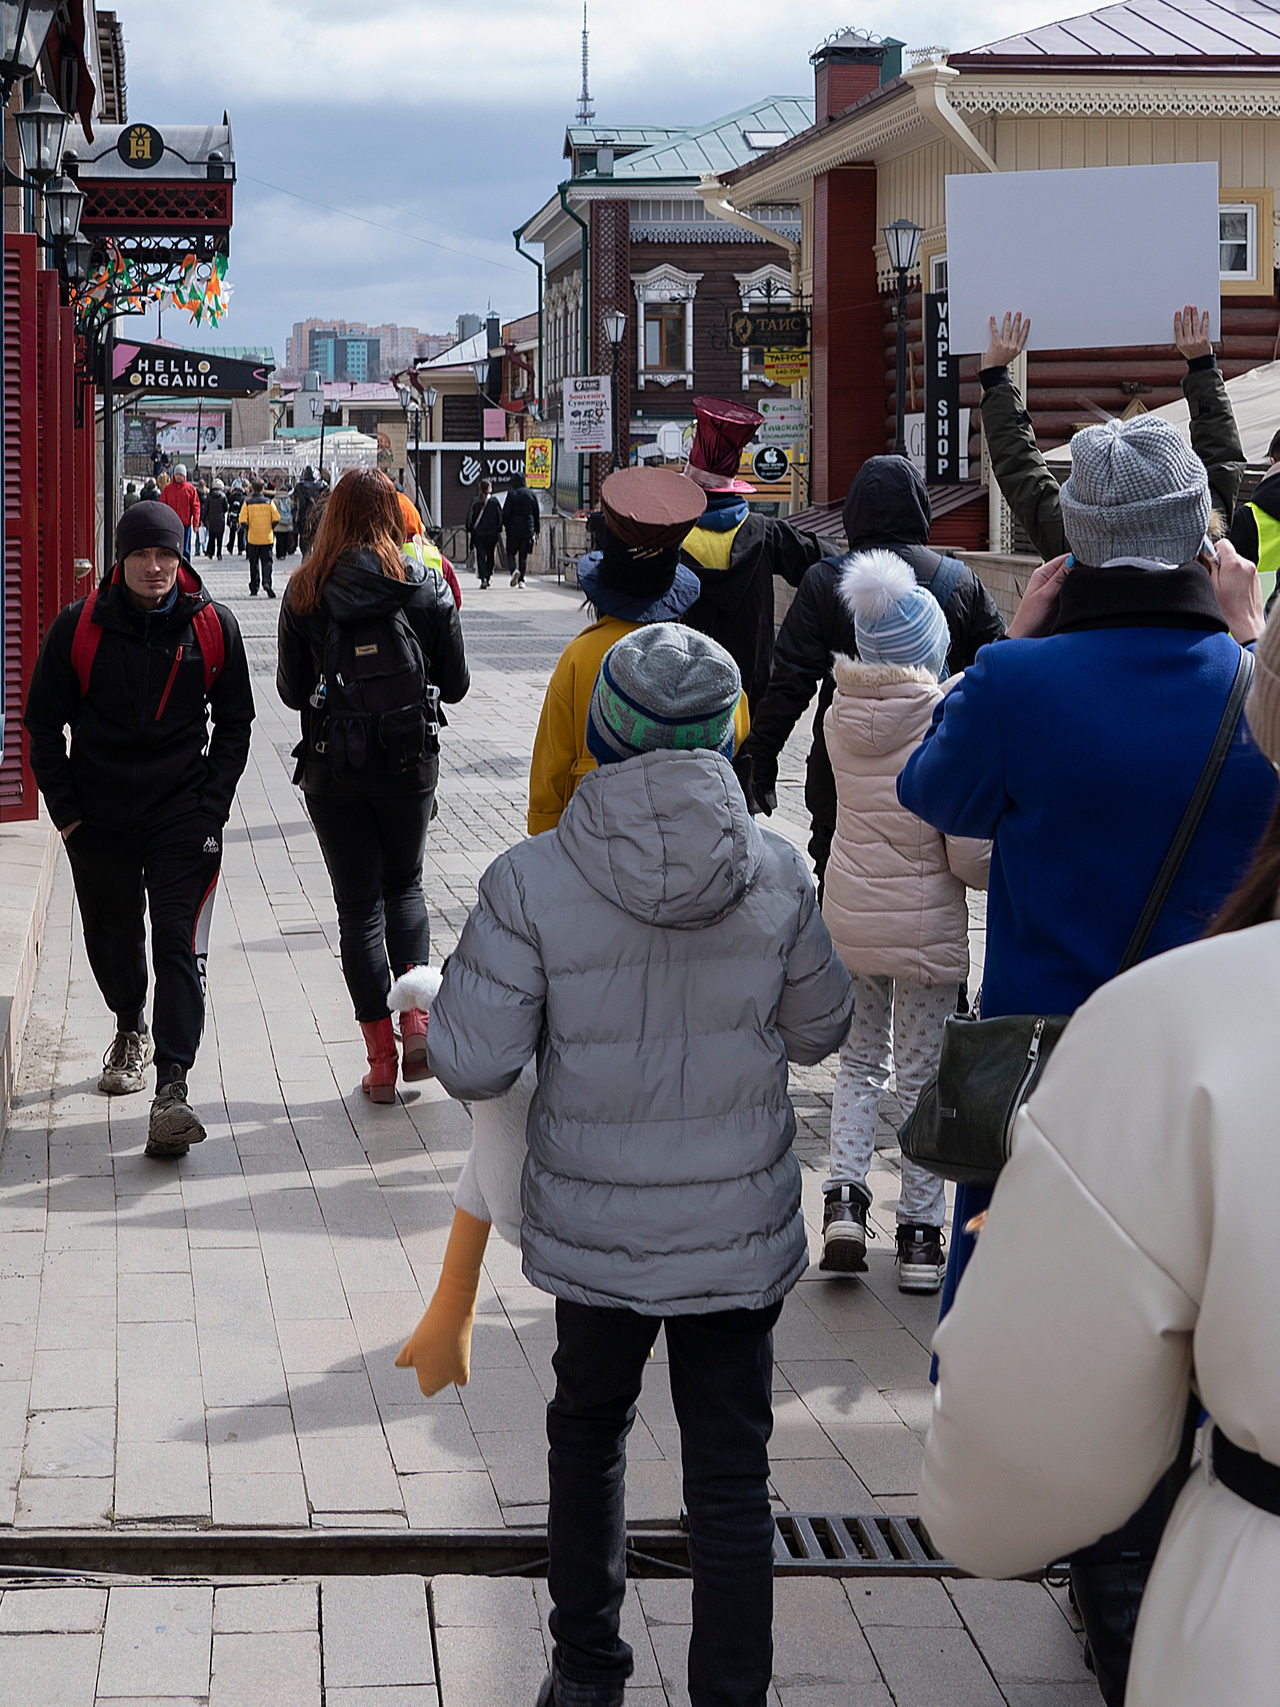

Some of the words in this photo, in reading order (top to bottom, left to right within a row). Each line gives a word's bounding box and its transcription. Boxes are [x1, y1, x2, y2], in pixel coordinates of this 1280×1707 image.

[757, 318, 801, 331] ТАИС
[937, 302, 948, 378] VAPE
[770, 353, 805, 362] TATTOO
[138, 359, 211, 373] HELLO
[130, 372, 219, 388] ORGANIC
[568, 392, 606, 400] Souvenirs
[937, 399, 949, 476] SHOP
